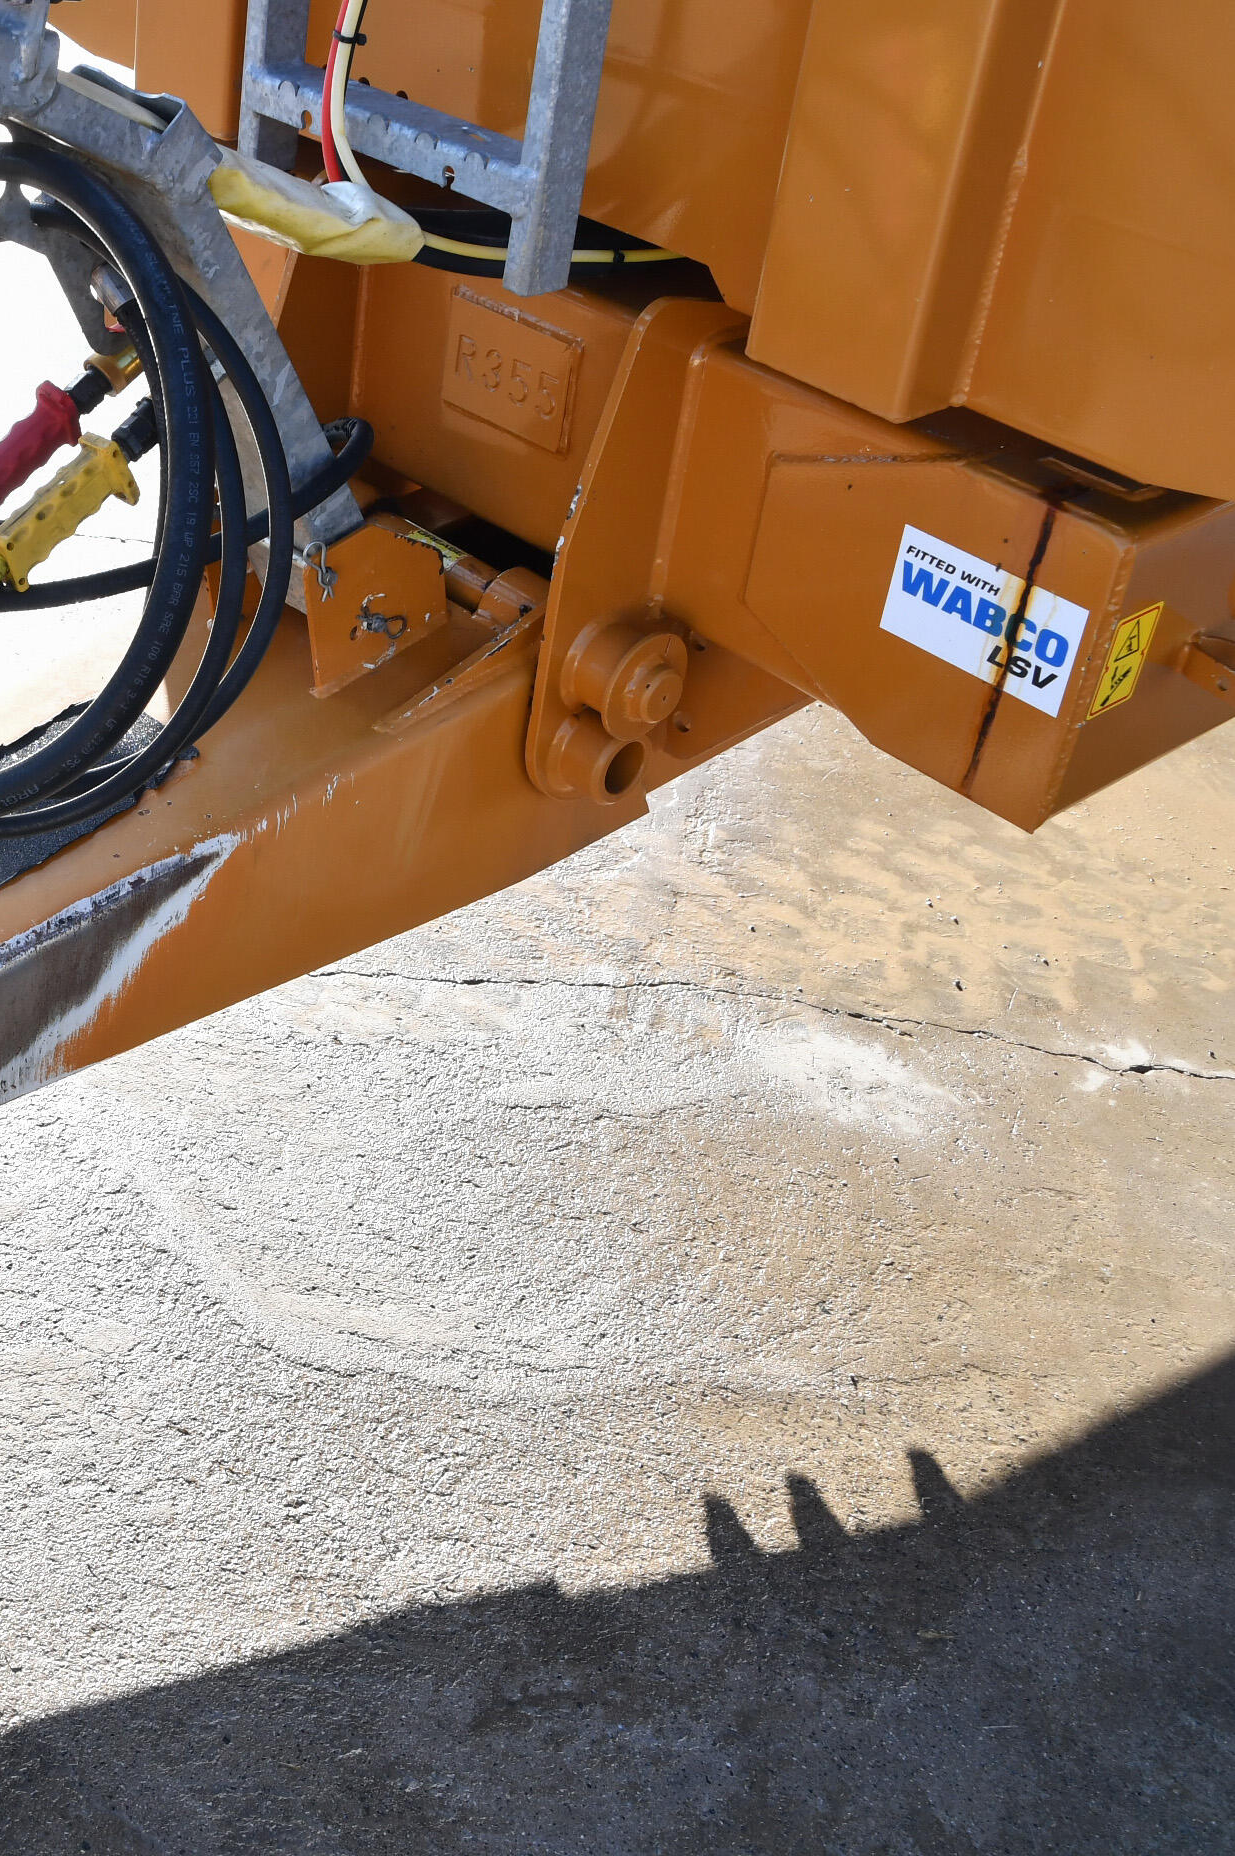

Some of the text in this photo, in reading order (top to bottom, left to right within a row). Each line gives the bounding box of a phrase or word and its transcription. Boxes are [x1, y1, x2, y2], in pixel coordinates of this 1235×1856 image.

[178, 347, 197, 397] PLUS
[454, 334, 559, 420] R355
[189, 432, 200, 447] EN
[176, 552, 190, 577] 215
[906, 545, 1001, 596] FITTED WITH
[902, 560, 1069, 668] WABCO
[134, 664, 151, 686] R16
[987, 645, 1058, 689] LSV
